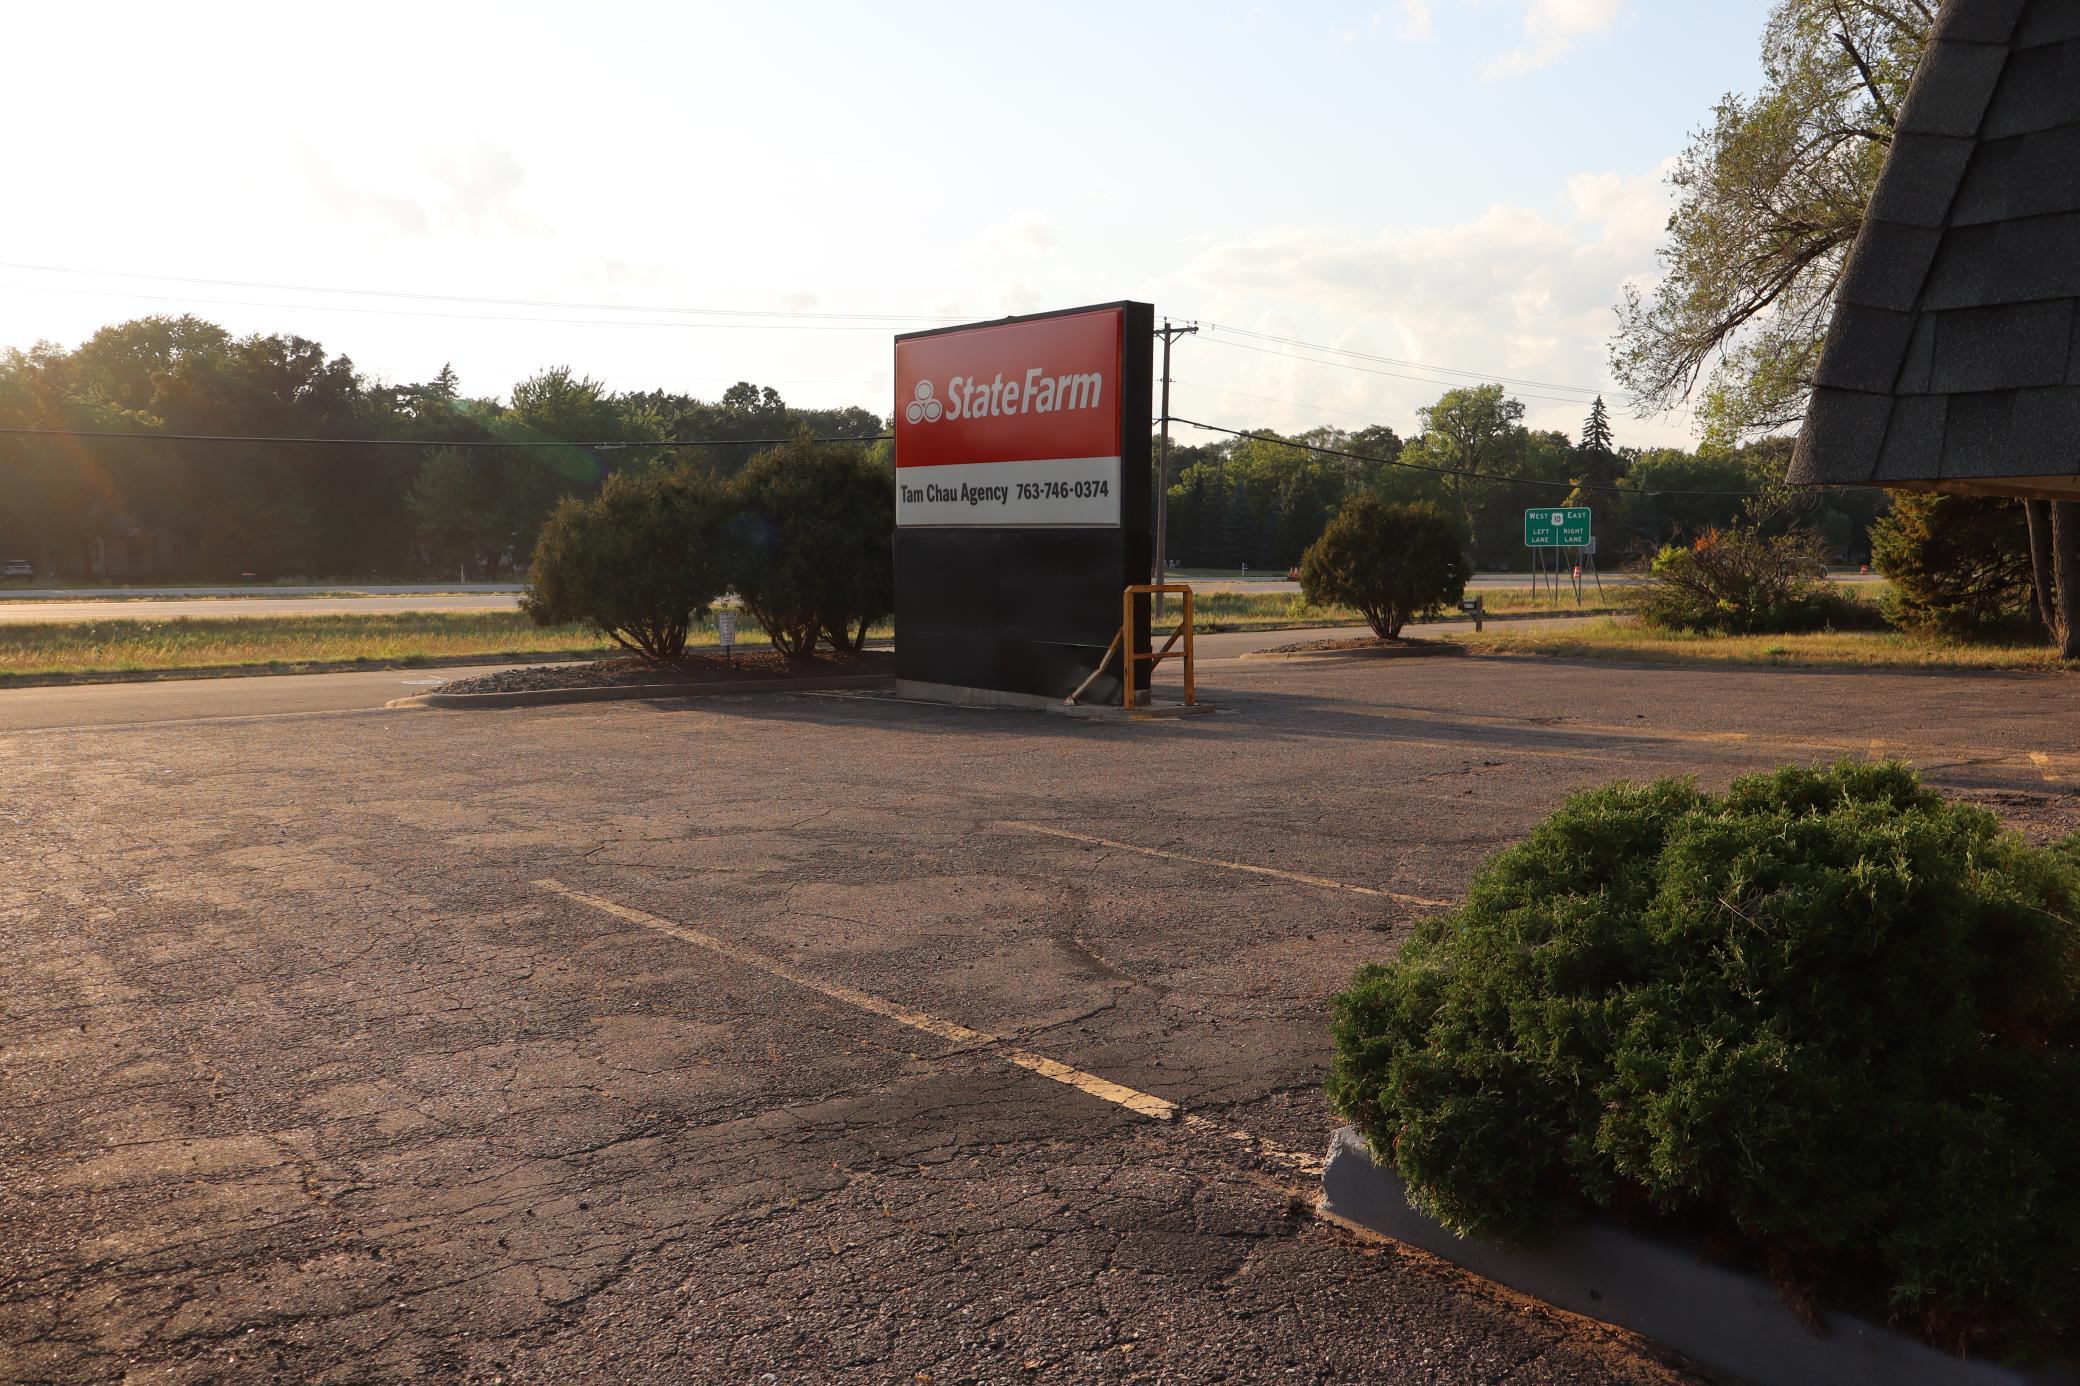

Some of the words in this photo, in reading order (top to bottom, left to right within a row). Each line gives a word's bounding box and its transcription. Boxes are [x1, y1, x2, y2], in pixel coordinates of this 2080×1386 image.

[901, 485, 924, 503] Tam
[927, 484, 957, 502] Chau
[961, 482, 1008, 505] Agency
[1016, 480, 1109, 500] 763-746-0374
[1553, 515, 1561, 523] 10
